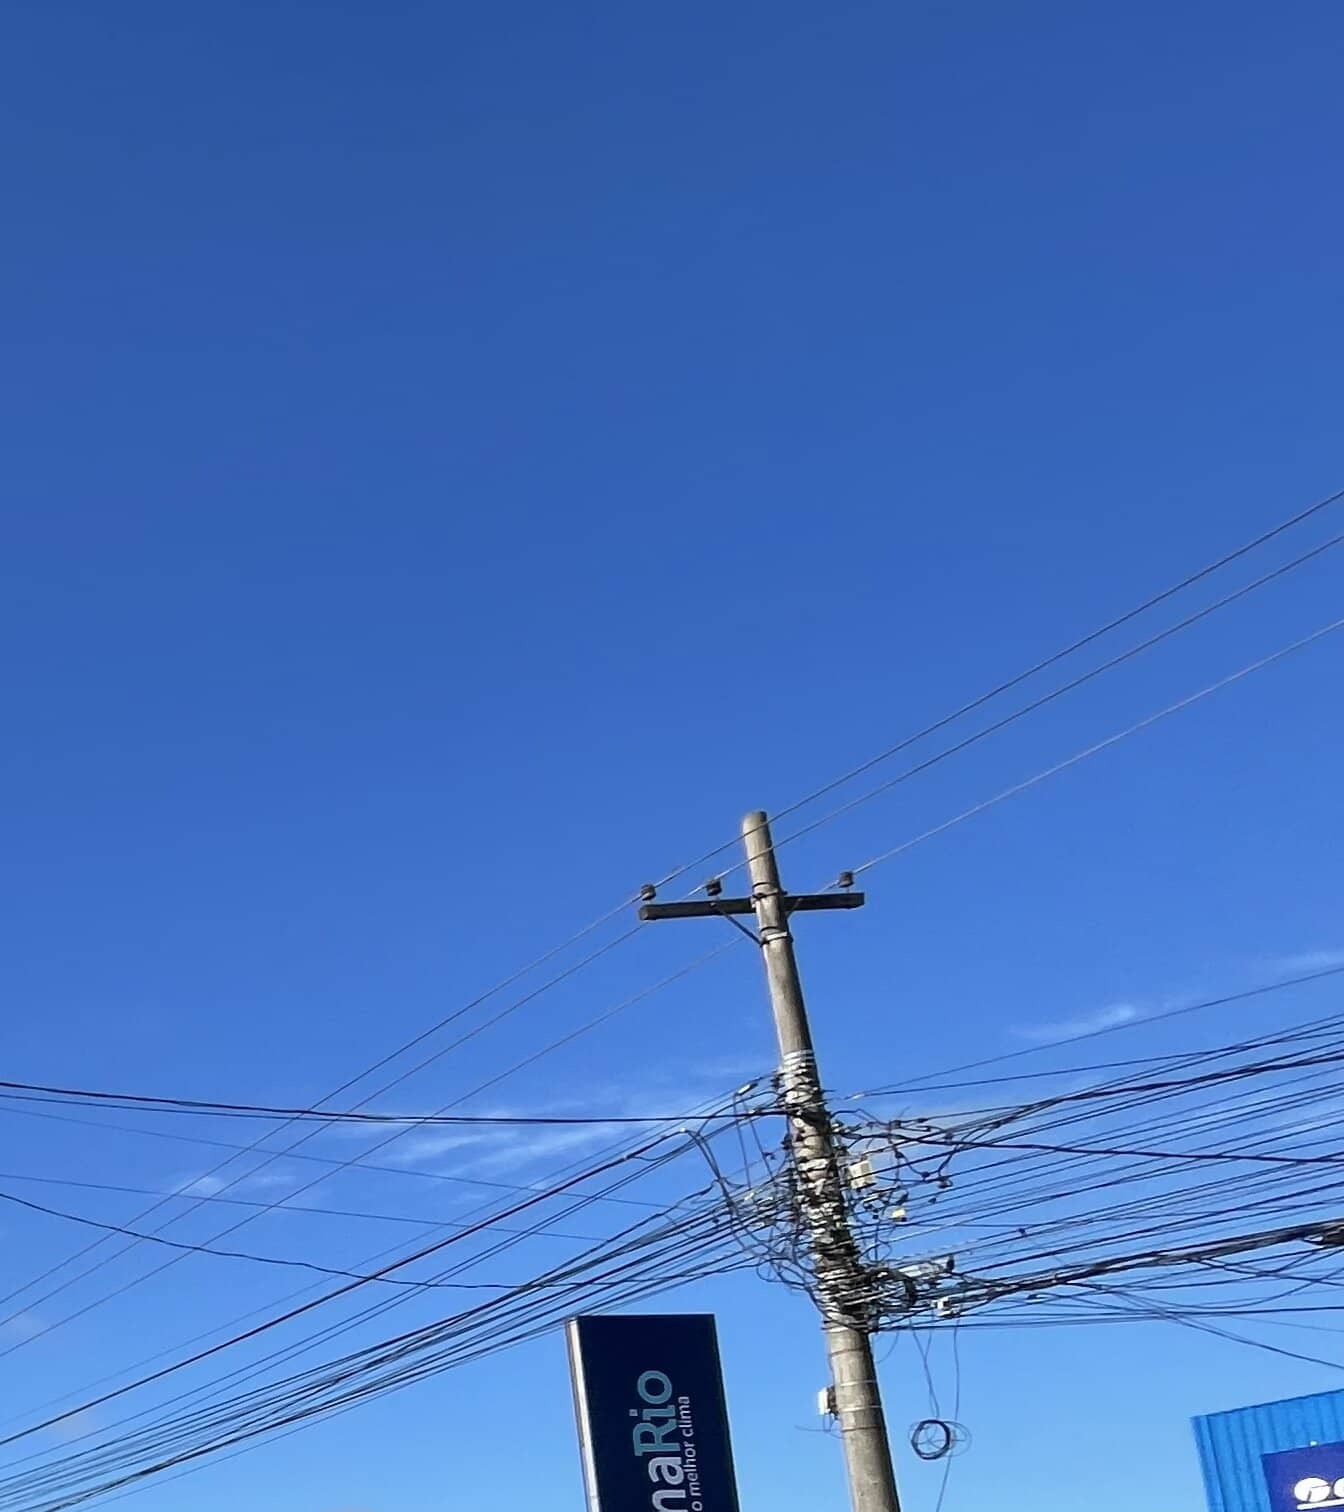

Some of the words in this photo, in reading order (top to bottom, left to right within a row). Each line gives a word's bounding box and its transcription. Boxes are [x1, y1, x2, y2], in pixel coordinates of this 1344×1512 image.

[677, 1395, 695, 1438] clima
[682, 1441, 704, 1497] melhor
[691, 1501, 704, 1512] o
